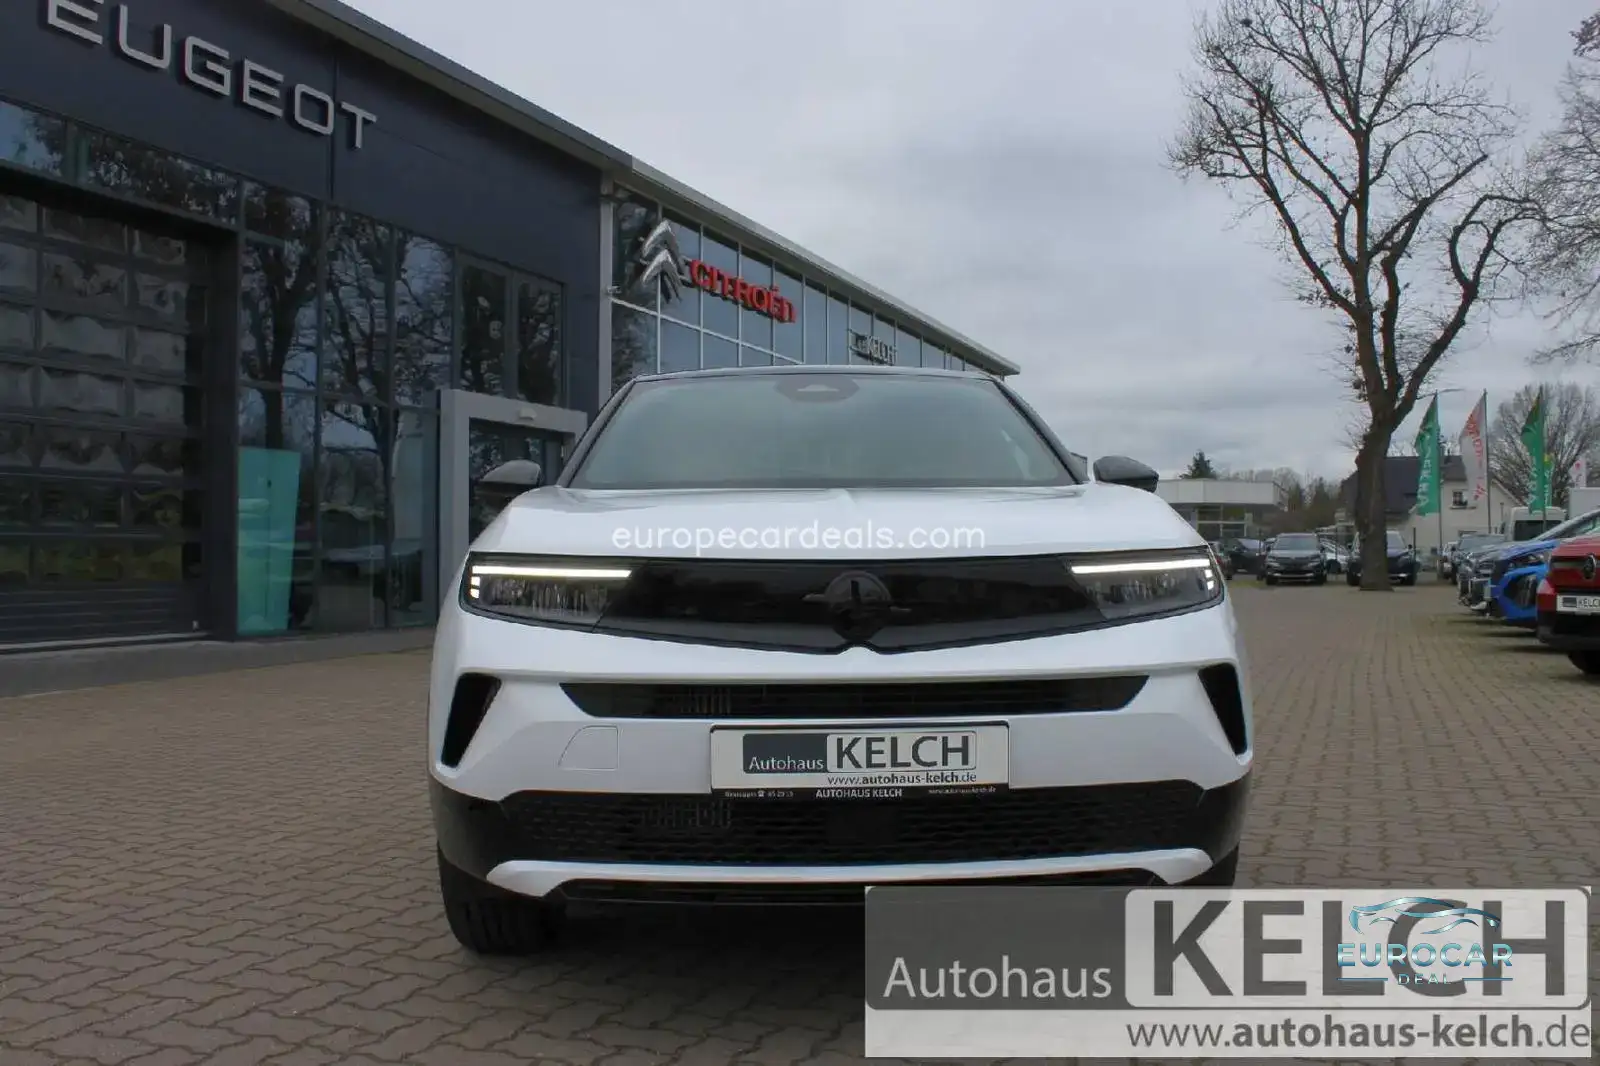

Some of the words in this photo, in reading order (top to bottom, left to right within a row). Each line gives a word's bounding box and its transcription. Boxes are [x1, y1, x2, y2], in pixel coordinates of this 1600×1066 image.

[749, 756, 823, 771] Autohaus
[836, 735, 969, 769] KELCH
[827, 772, 977, 785] www.autohaus-kelch.de
[815, 788, 870, 799] AUTOHAUS
[872, 788, 902, 798] KELCH
